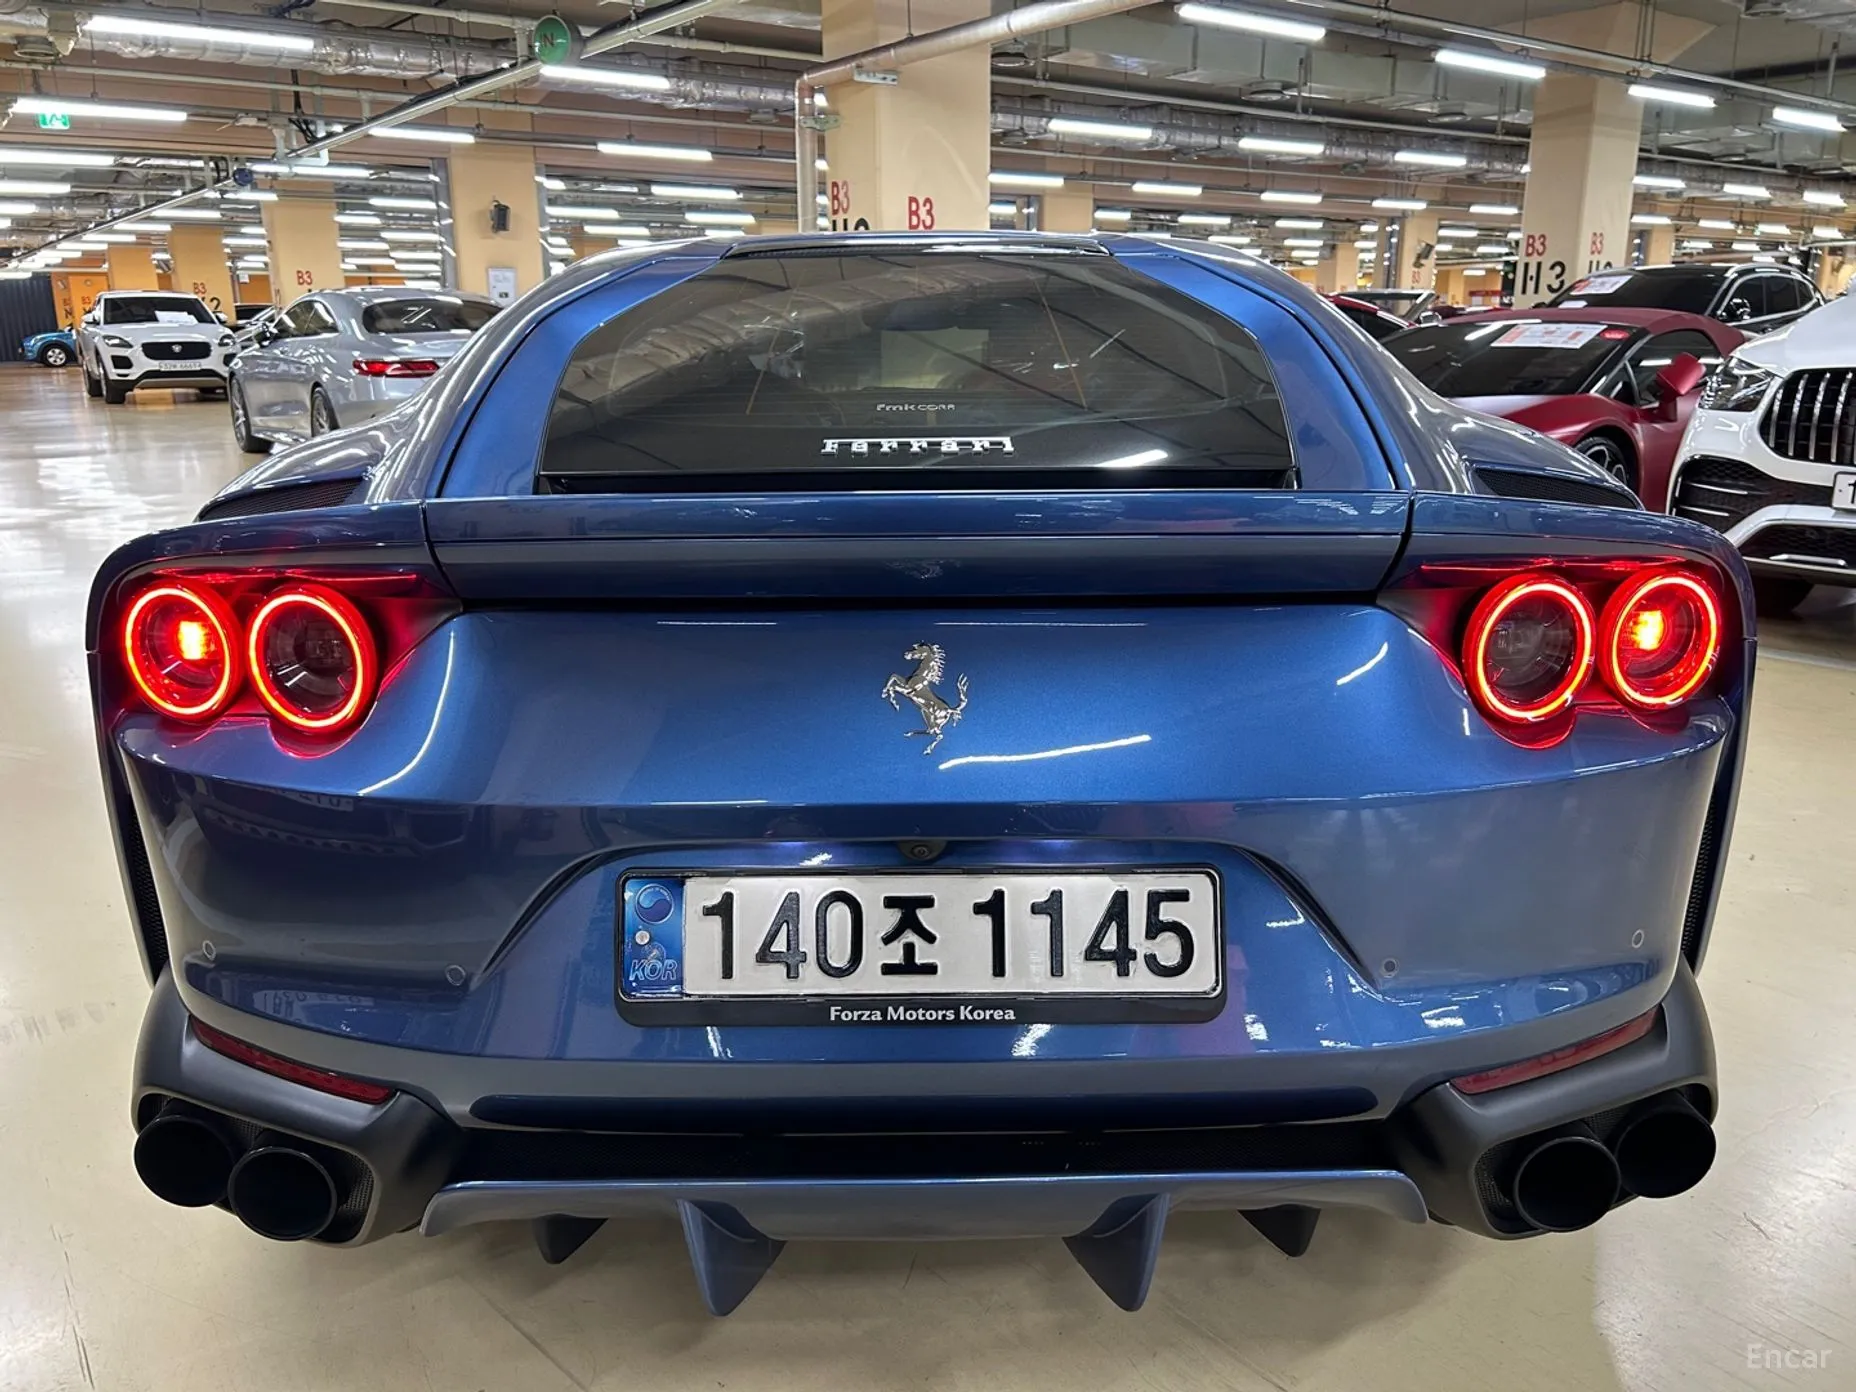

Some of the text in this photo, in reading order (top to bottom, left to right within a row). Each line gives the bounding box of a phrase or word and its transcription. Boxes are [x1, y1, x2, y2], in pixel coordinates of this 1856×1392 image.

[831, 180, 850, 215] B3
[907, 196, 935, 230] B3
[1525, 234, 1547, 257] B3
[1590, 232, 1604, 255] B3
[193, 282, 207, 294] B3
[296, 270, 313, 285] B3
[821, 436, 1015, 456] Ferrari
[703, 889, 1195, 979] 140조 1145
[629, 959, 677, 981] KOR
[830, 1005, 1016, 1021] Forza Motors Korea
